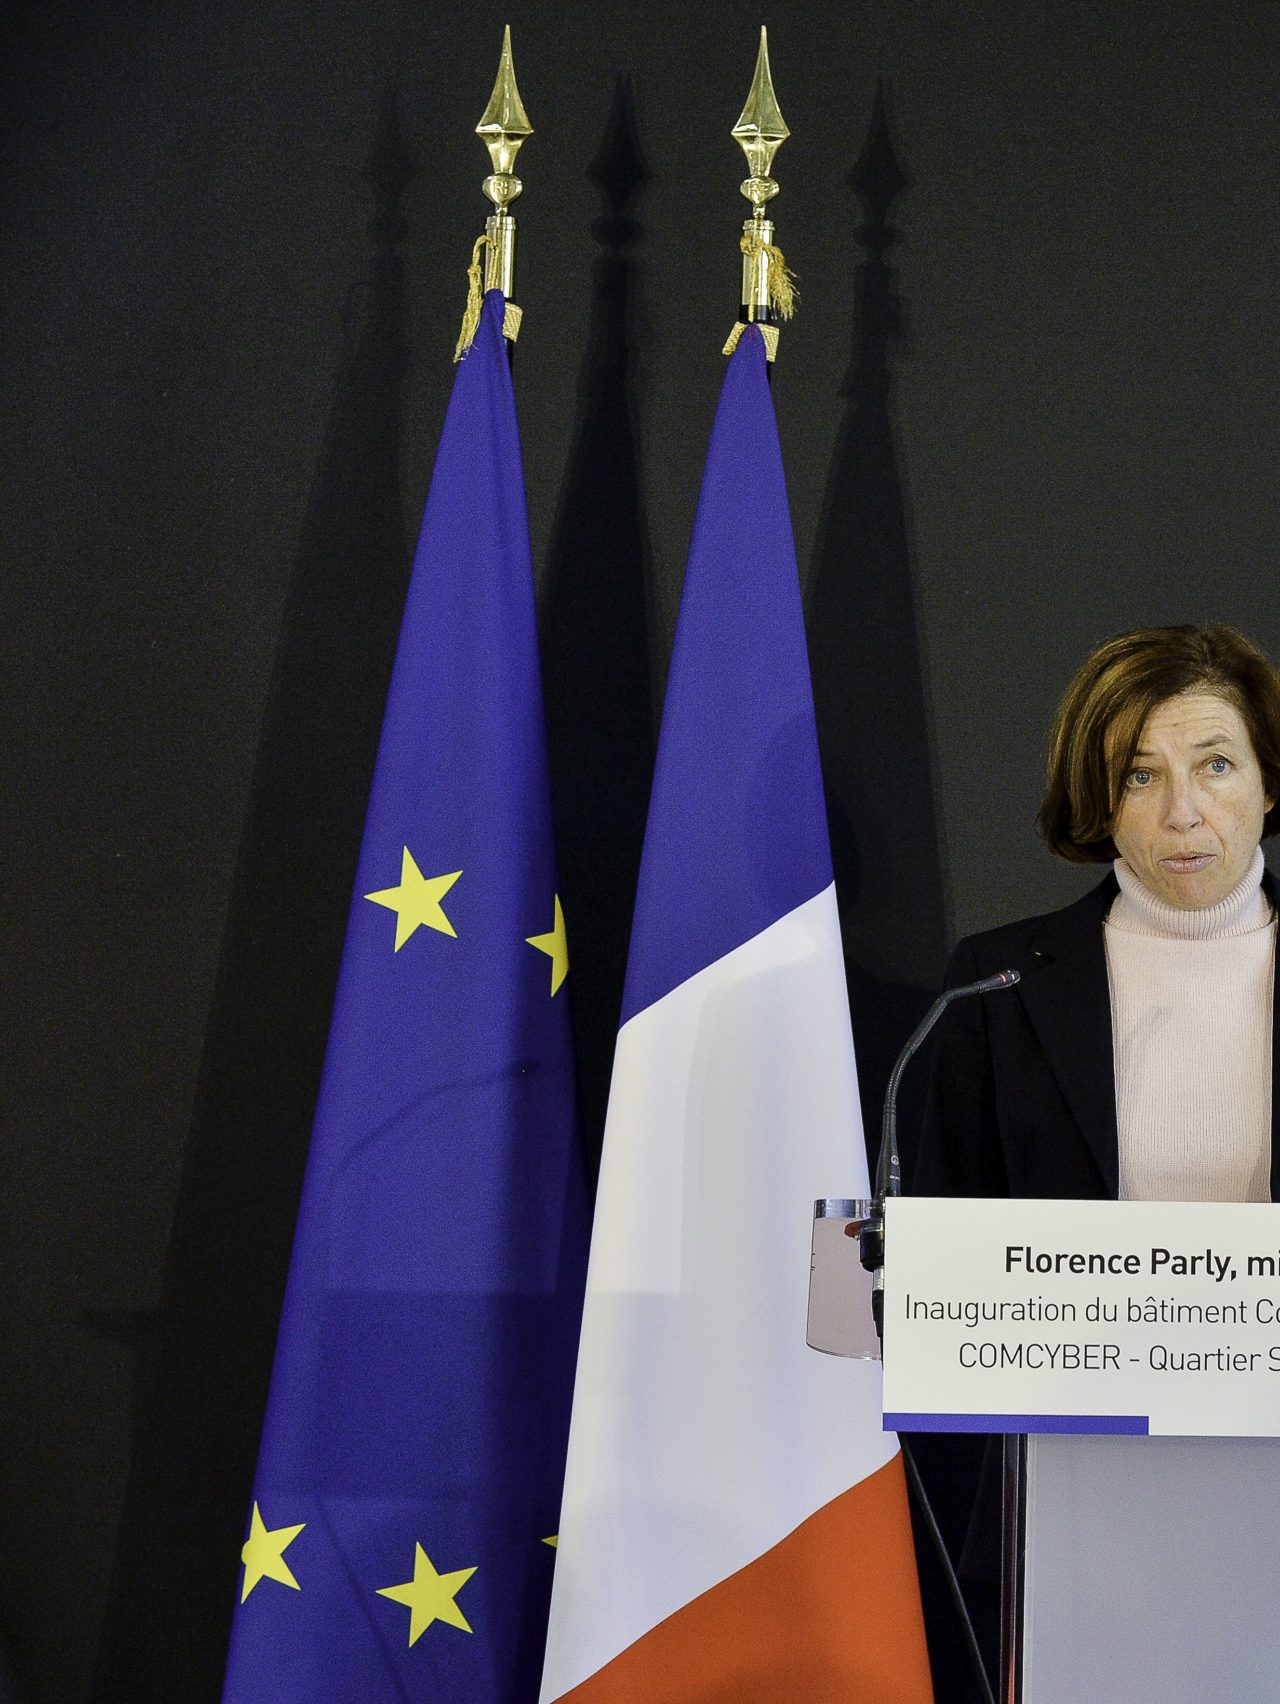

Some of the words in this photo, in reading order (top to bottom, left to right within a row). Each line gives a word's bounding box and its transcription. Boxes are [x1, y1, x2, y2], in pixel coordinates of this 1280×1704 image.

[1005, 1246, 1141, 1275] Florence
[1151, 1248, 1237, 1283] Parly,
[904, 1293, 1076, 1328] Inauguration
[1085, 1296, 1118, 1322] du
[1127, 1296, 1248, 1324] bâtiment
[959, 1342, 1121, 1370] COMCYBER
[1149, 1344, 1262, 1372] Quartier
